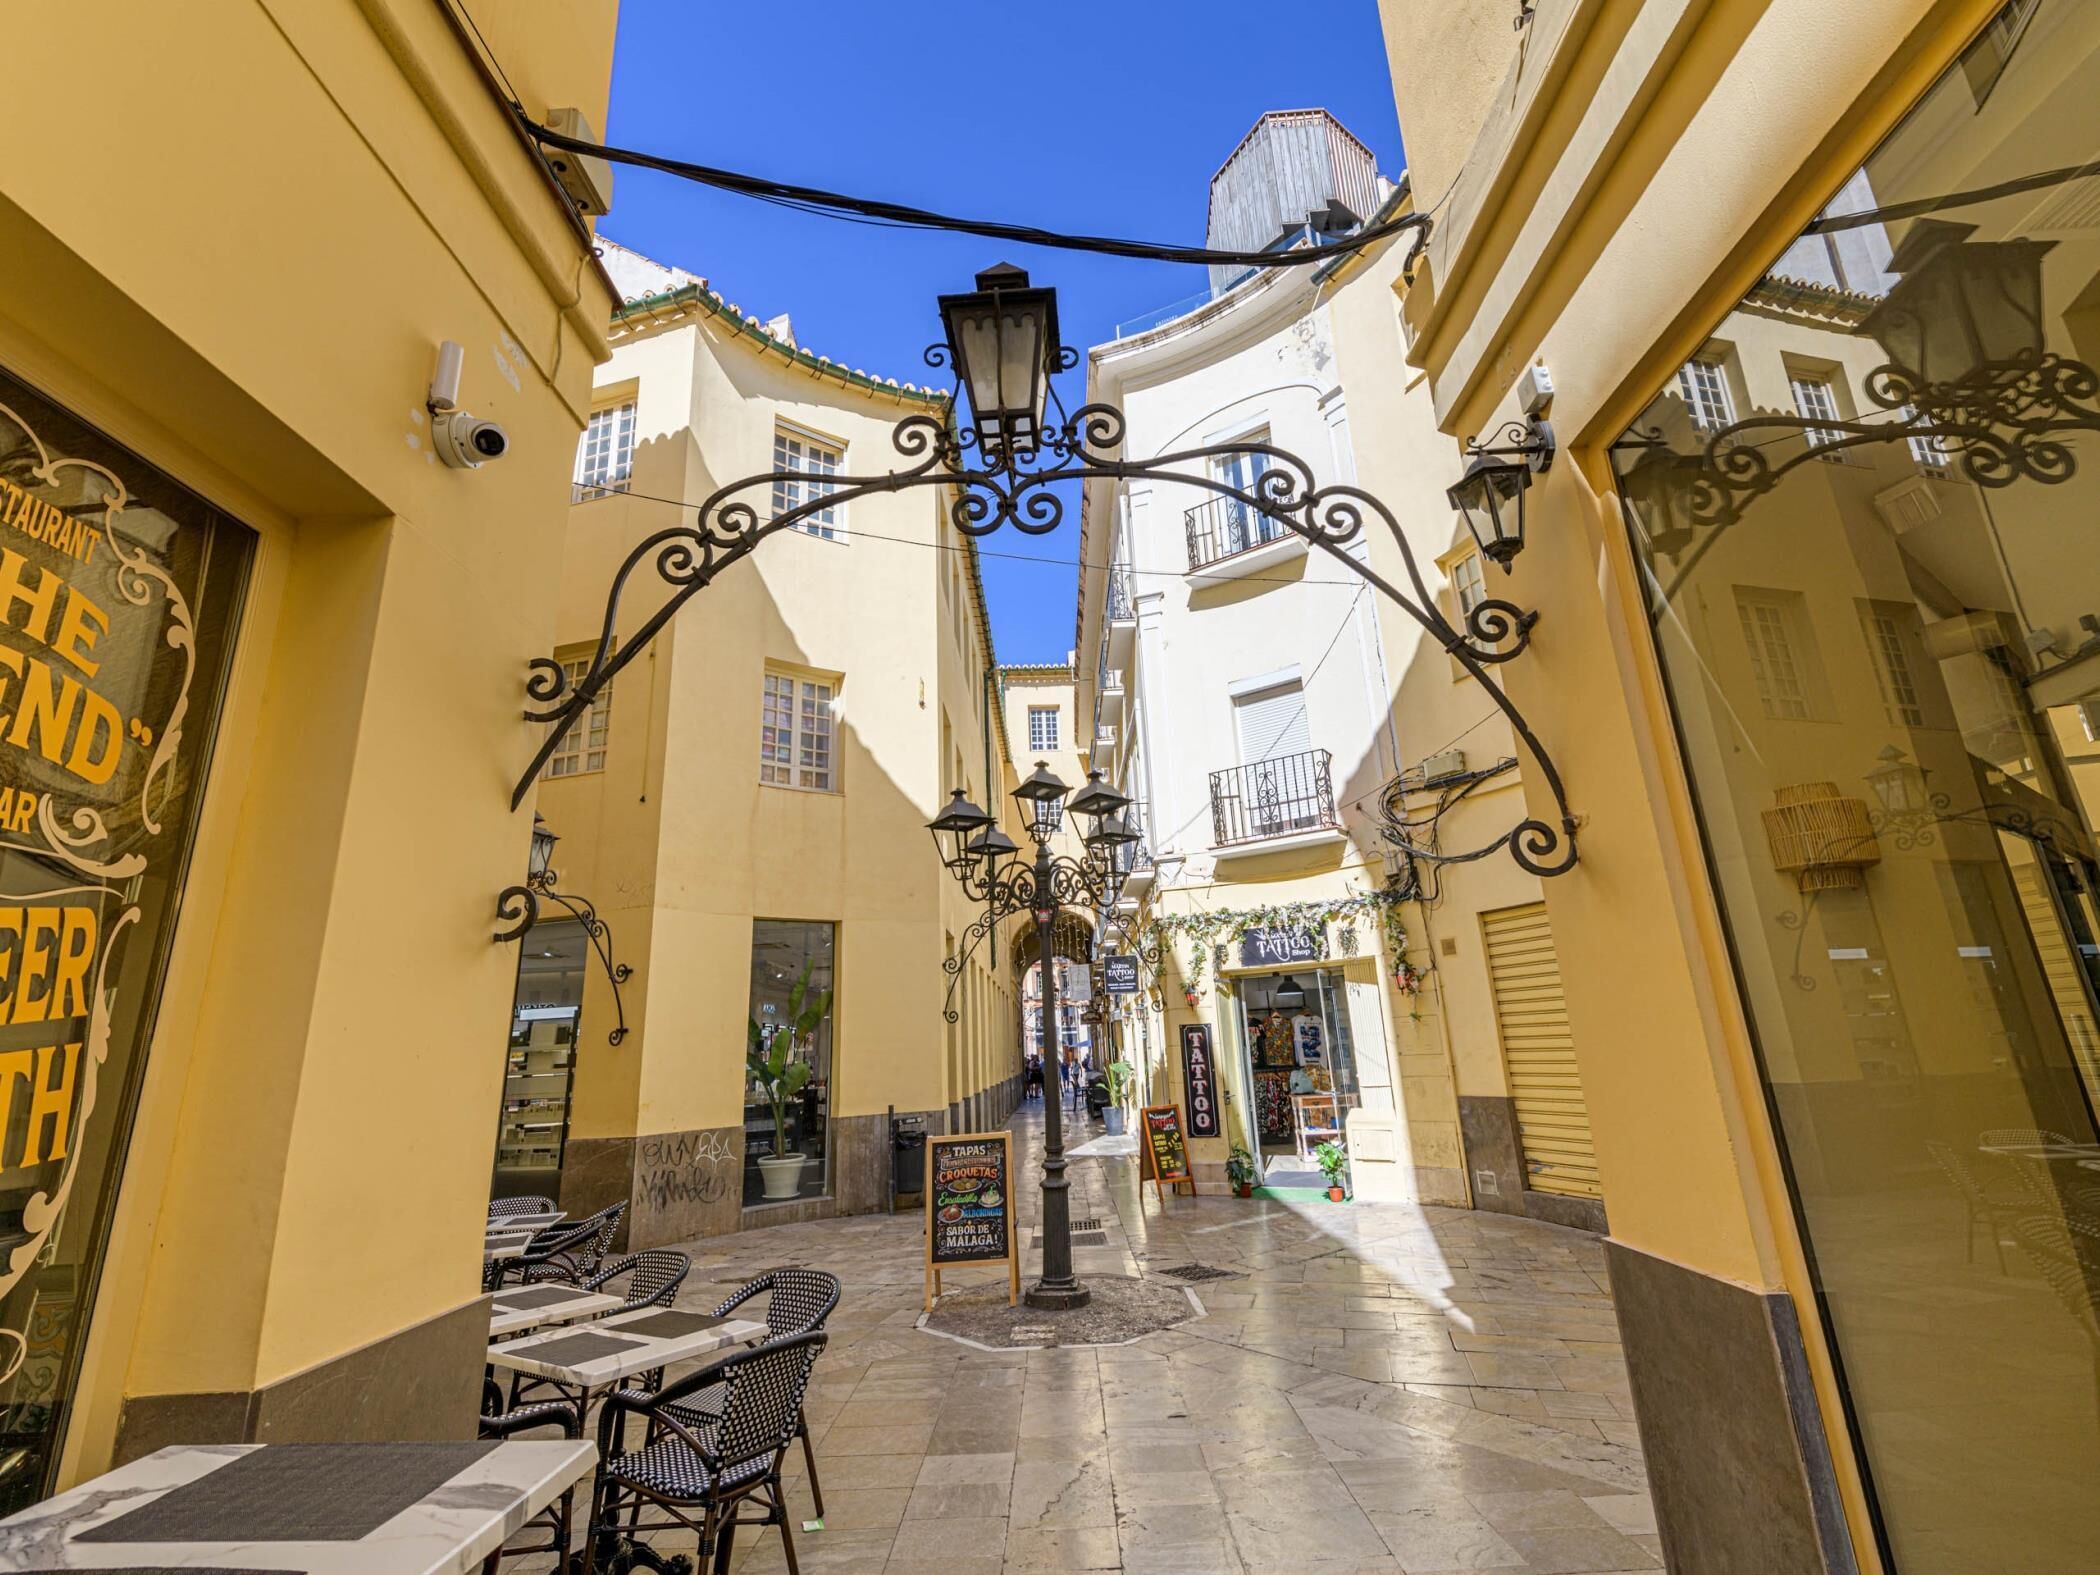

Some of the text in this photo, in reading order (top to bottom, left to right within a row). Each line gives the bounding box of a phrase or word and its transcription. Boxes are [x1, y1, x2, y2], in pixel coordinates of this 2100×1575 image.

[1107, 968, 1135, 981] TATTOO
[1188, 1032, 1210, 1128] TATTOO
[953, 1145, 986, 1157] TAPAS
[940, 1167, 998, 1183] CROQUETAS
[946, 1224, 990, 1236] SABOR DE
